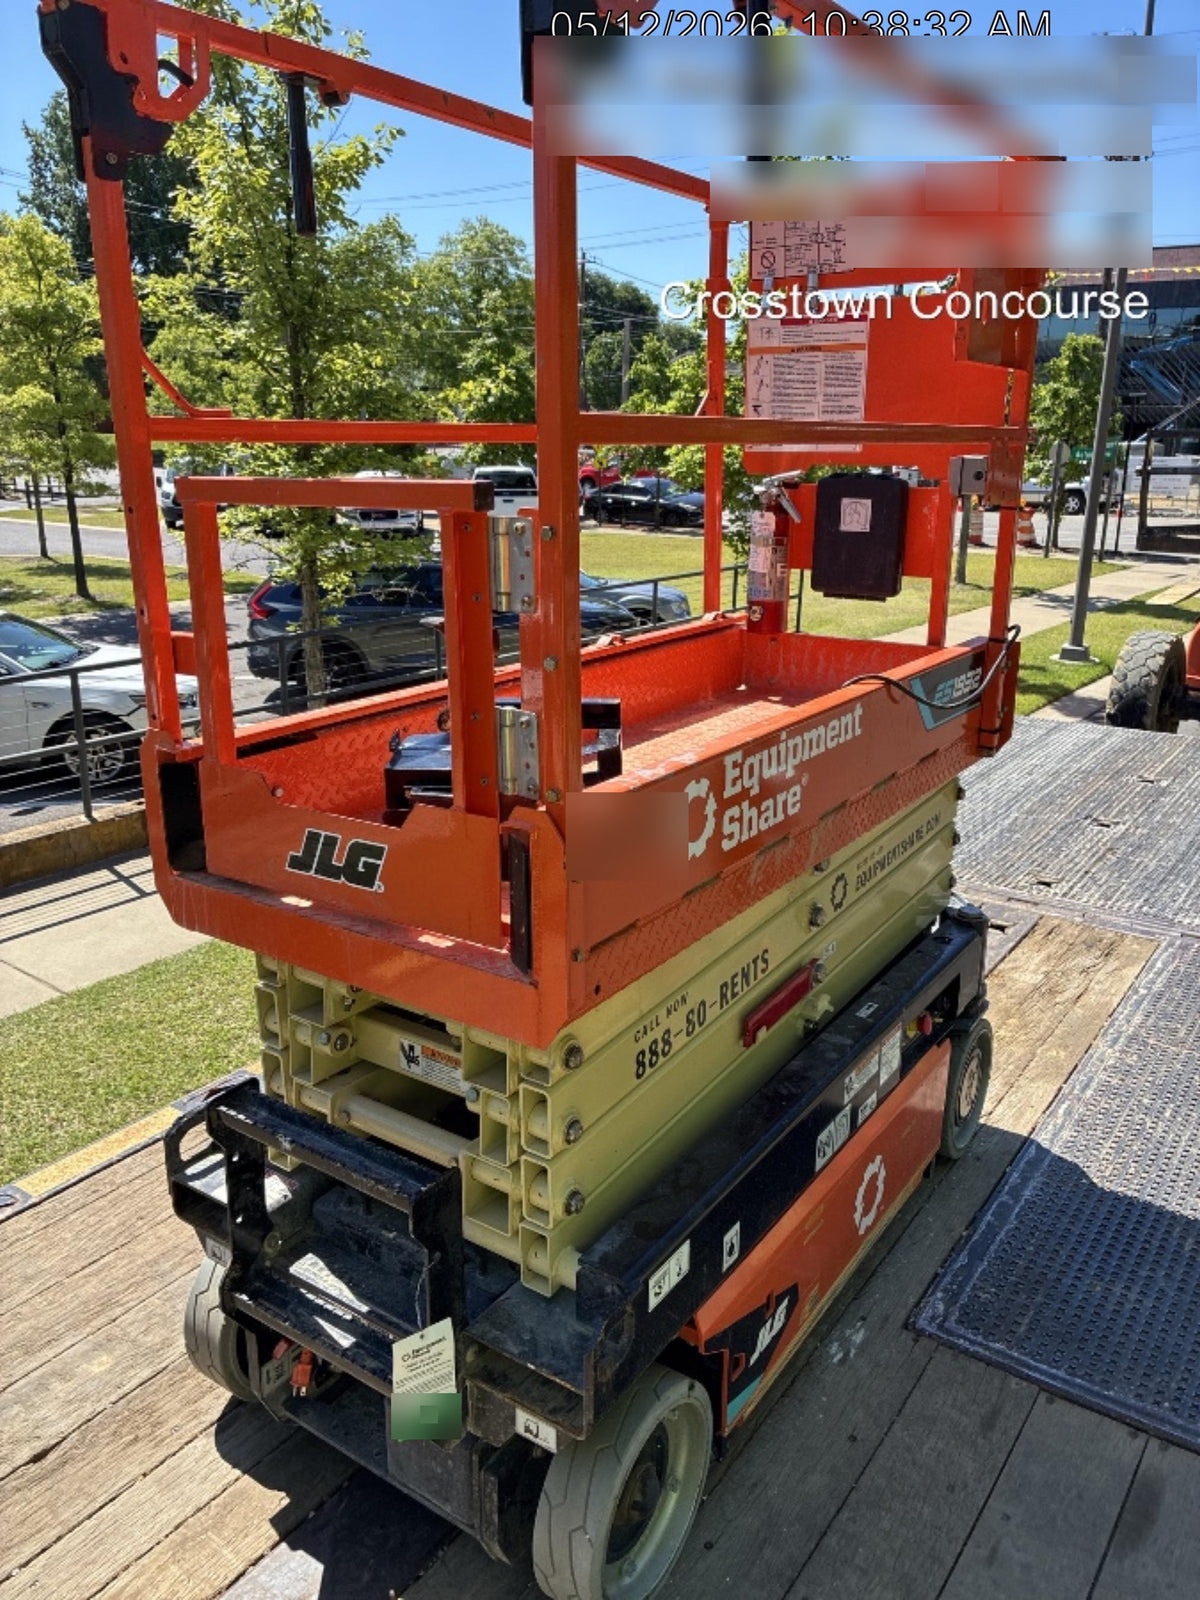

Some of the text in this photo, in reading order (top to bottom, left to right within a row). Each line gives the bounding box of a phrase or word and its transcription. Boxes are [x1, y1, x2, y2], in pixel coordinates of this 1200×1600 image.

[723, 702, 863, 799] Equipment
[285, 828, 388, 892] JLG
[634, 948, 769, 1080] 888-80-RENTS
[634, 1014, 661, 1043] CALL
